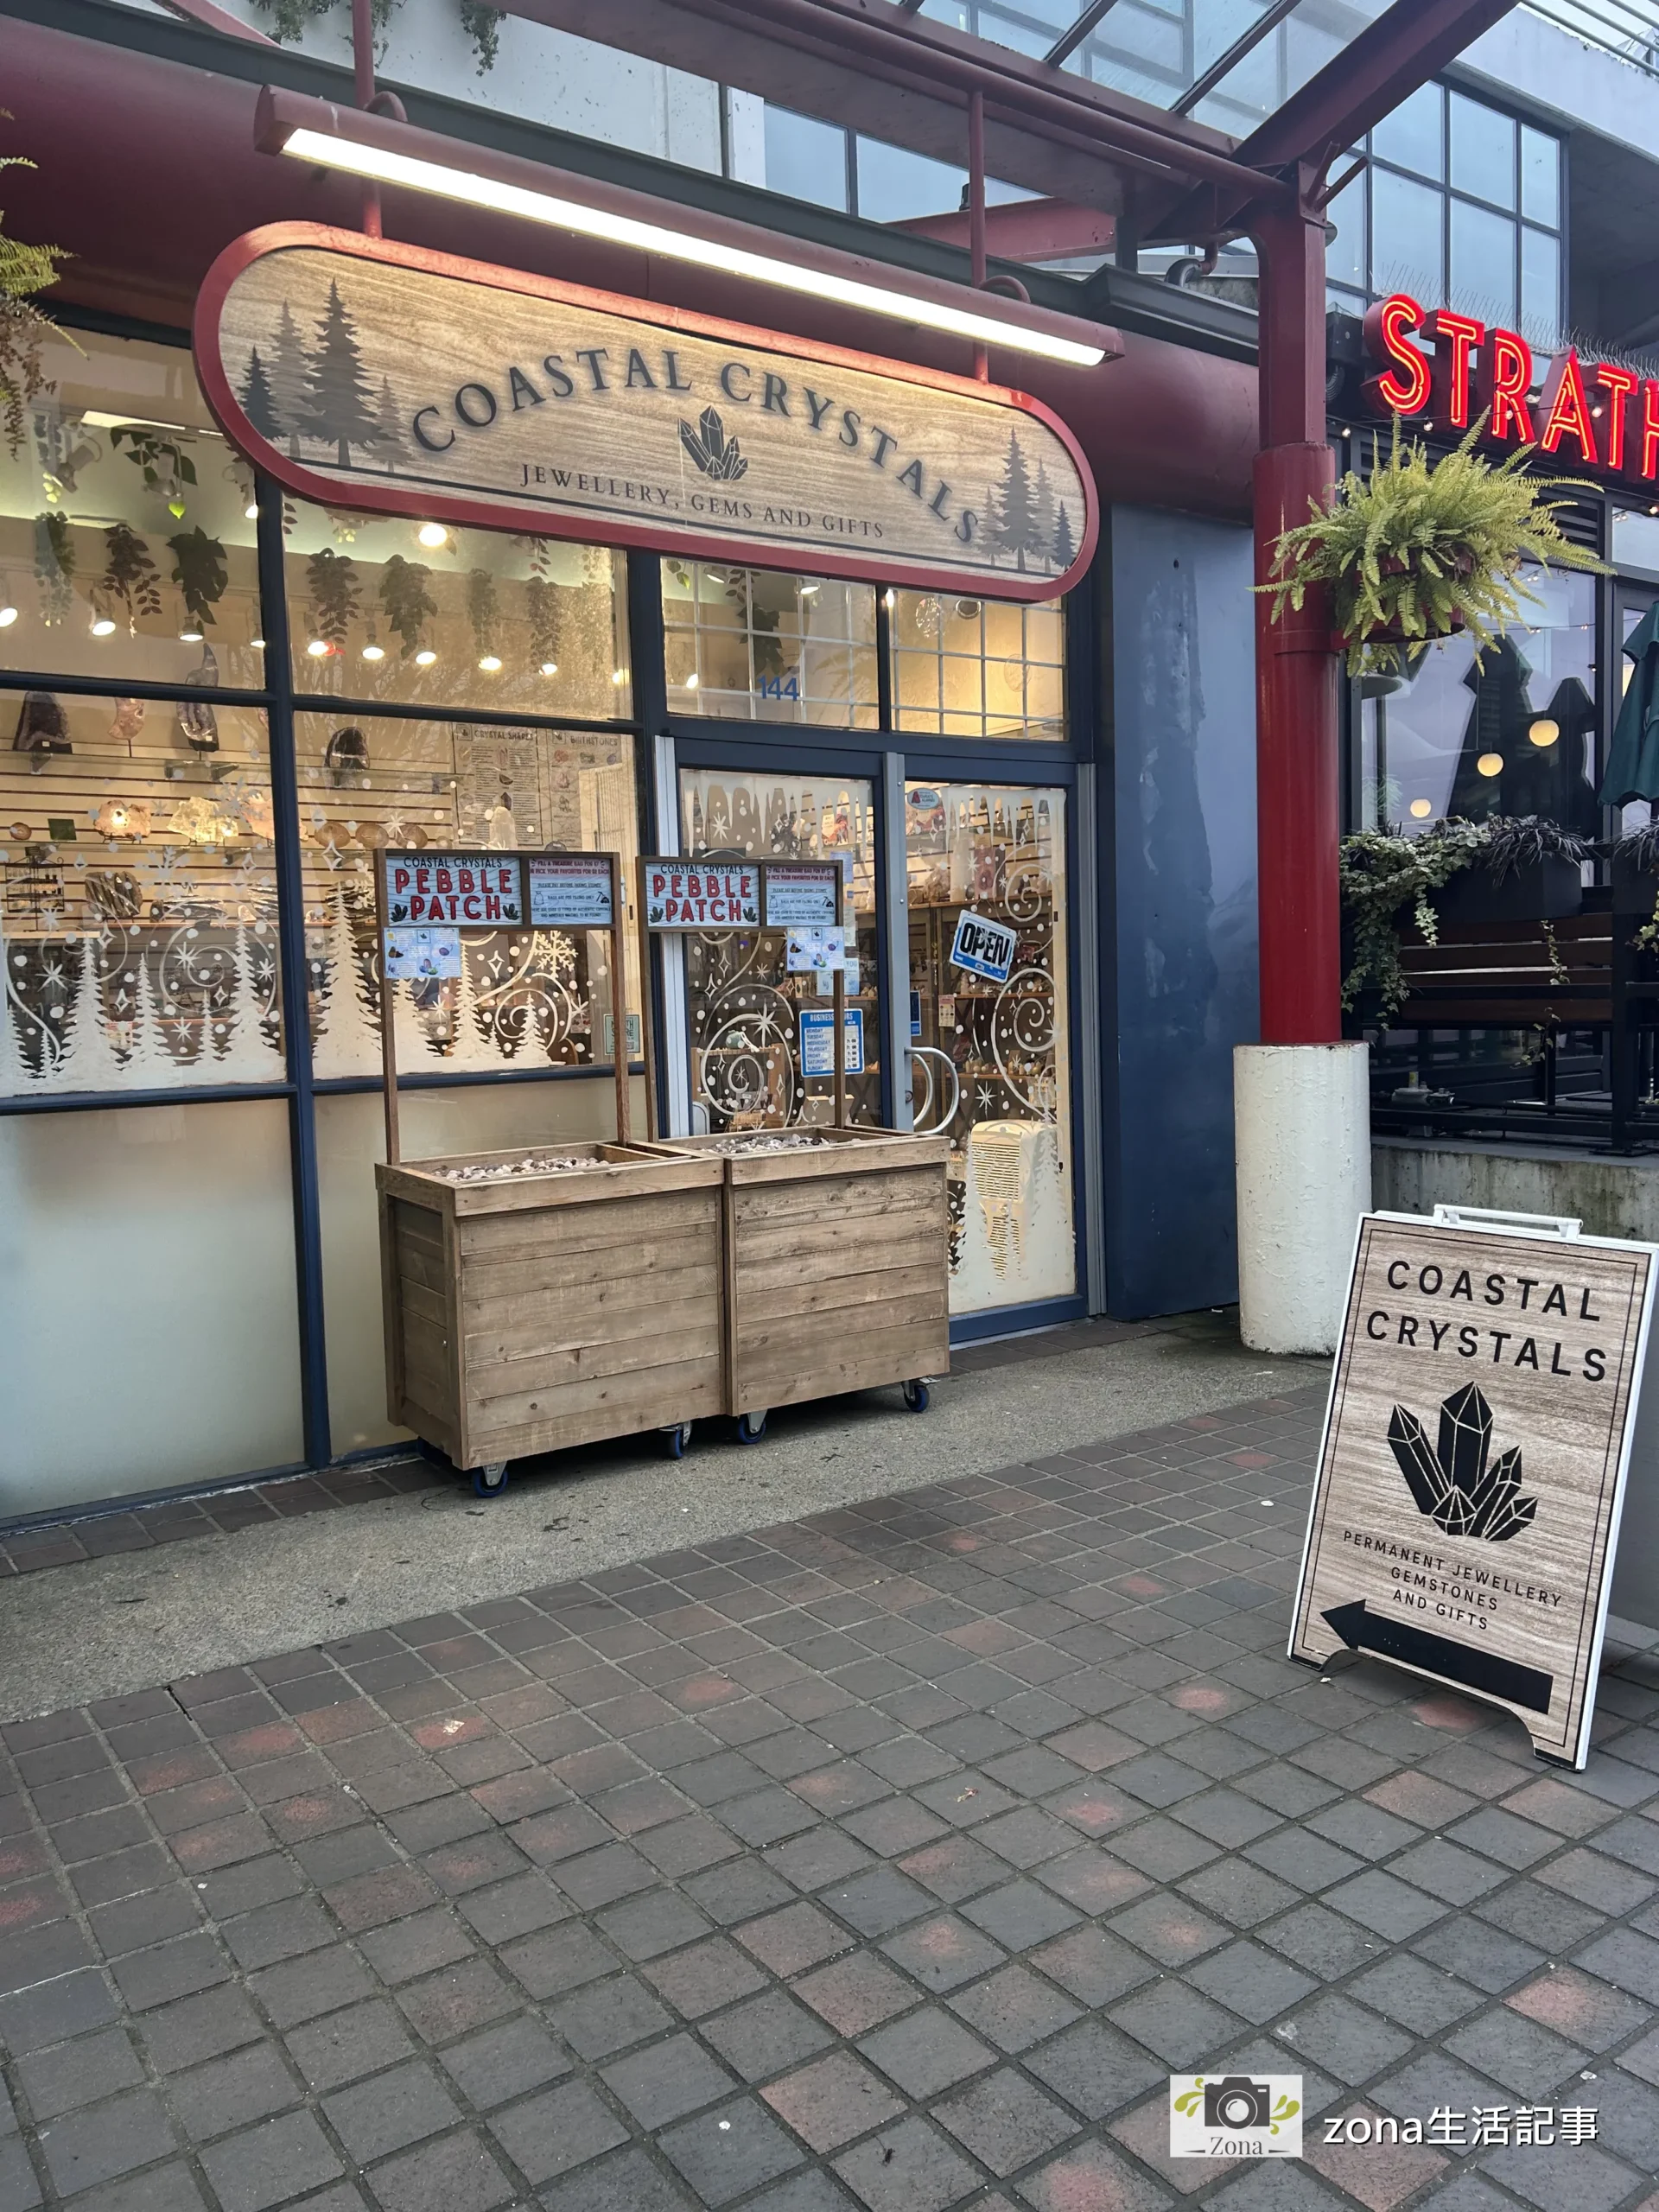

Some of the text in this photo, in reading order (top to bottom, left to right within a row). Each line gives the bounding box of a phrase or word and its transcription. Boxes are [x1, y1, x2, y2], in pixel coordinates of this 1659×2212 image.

[412, 348, 979, 543] COASTAL CRYSTALS
[520, 463, 884, 537] JEWELLERY, GEMS AND GIFTS
[757, 674, 800, 702] 144
[404, 857, 502, 868] COASTAL CRYSTALS
[660, 864, 744, 875] COASTAL CRYSTALS
[395, 868, 512, 894] PEBBLE
[653, 875, 752, 898] PEBBLE
[410, 895, 501, 920] PATCH
[665, 899, 741, 922] PATCH
[960, 922, 1010, 967] OPEN
[810, 1013, 835, 1022] BUSINESS
[1387, 1259, 1602, 1323] COASTAL
[1366, 1310, 1607, 1382] CRYSTALS
[1343, 1529, 1563, 1609] PERMANENT JEWELLERY
[1389, 1565, 1499, 1611] GEMSTONES
[1392, 1587, 1489, 1630] AND GIFTS
